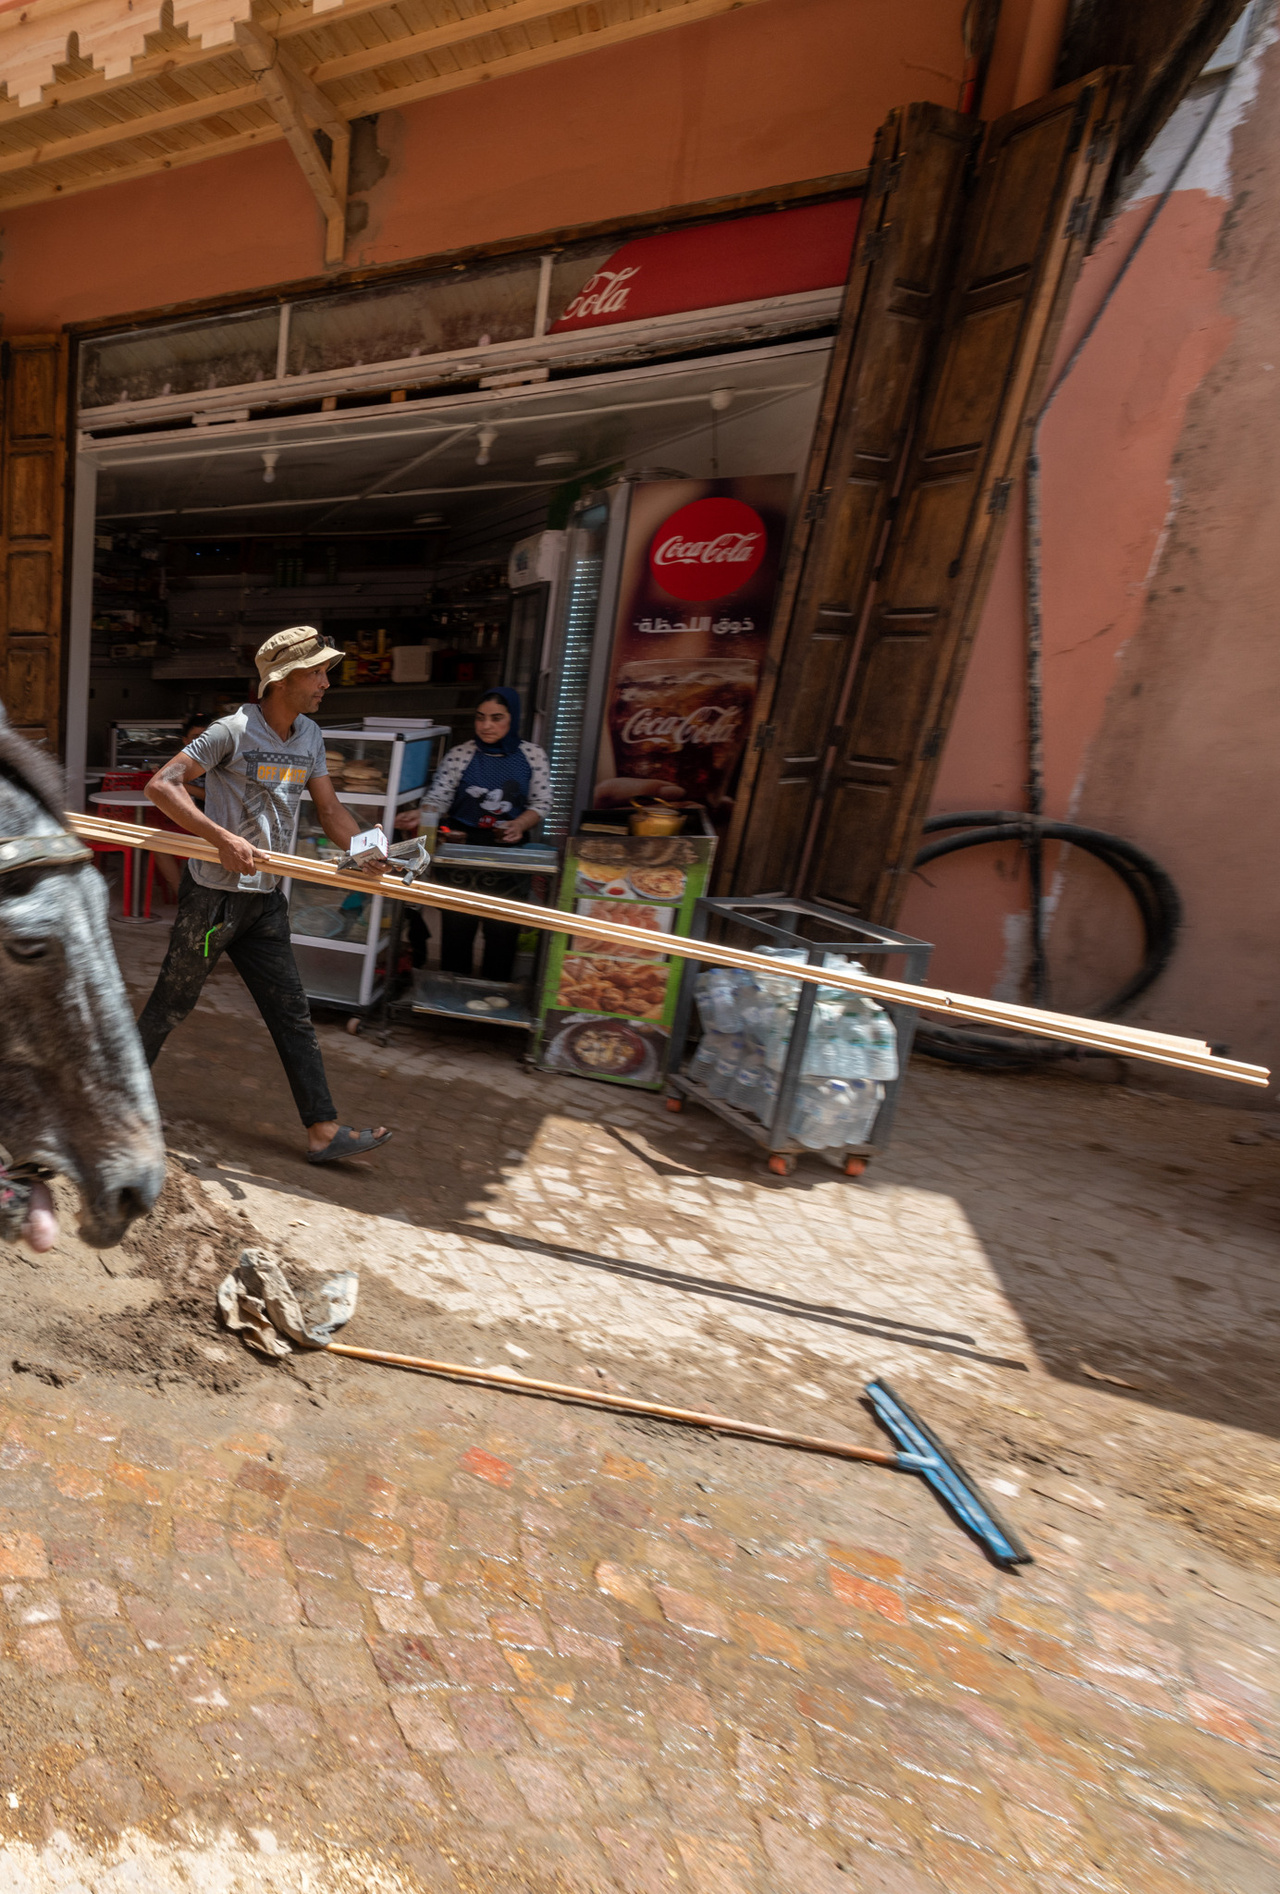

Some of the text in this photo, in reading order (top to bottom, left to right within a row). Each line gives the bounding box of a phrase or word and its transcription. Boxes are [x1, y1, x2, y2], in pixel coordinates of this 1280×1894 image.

[654, 532, 762, 566] Coca-Cola
[638, 616, 755, 635] ذوق اللحظة
[621, 705, 743, 744] Coca-Cola
[258, 765, 306, 783] OFF WHITE
